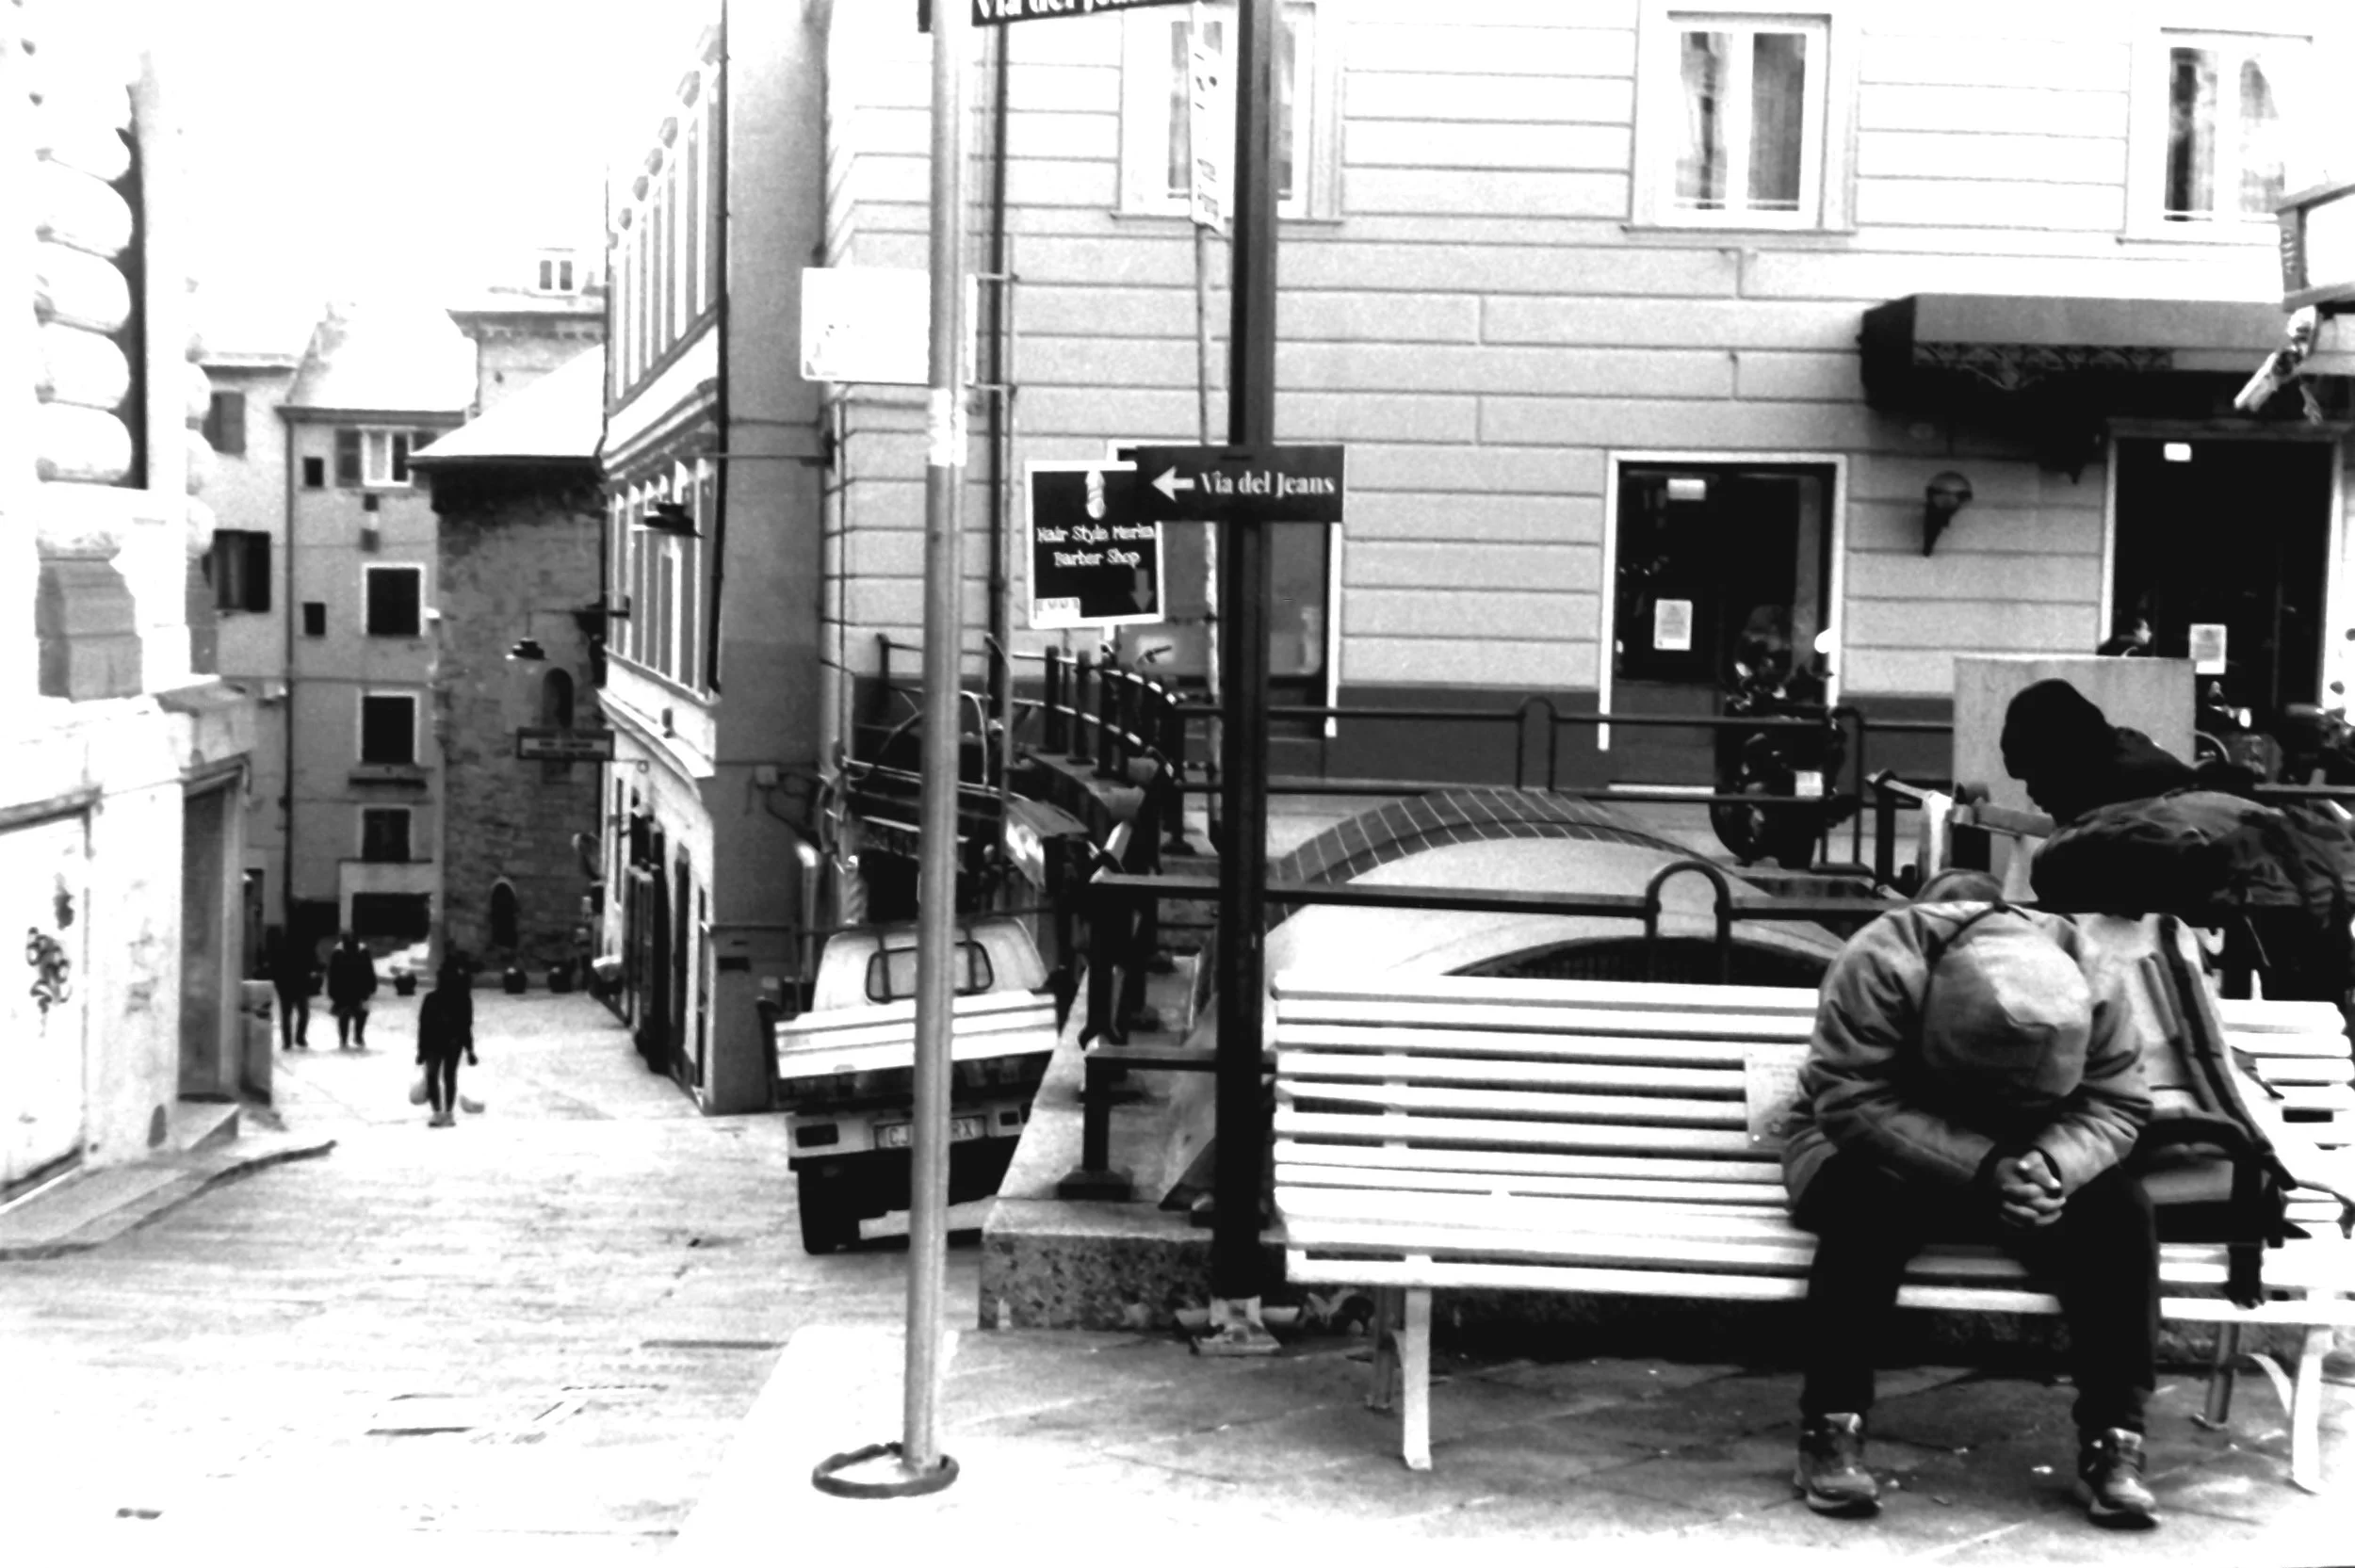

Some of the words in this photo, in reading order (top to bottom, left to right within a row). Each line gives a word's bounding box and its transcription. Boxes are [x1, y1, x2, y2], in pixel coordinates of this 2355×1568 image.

[976, 0, 1023, 19] Via
[1028, 0, 1076, 13] de
[1200, 471, 1233, 493] Via
[1238, 470, 1271, 493] del
[1276, 472, 1336, 499] Jeans
[1072, 524, 1110, 545] Style
[1053, 549, 1104, 567] Barber
[1107, 547, 1141, 569] Shop
